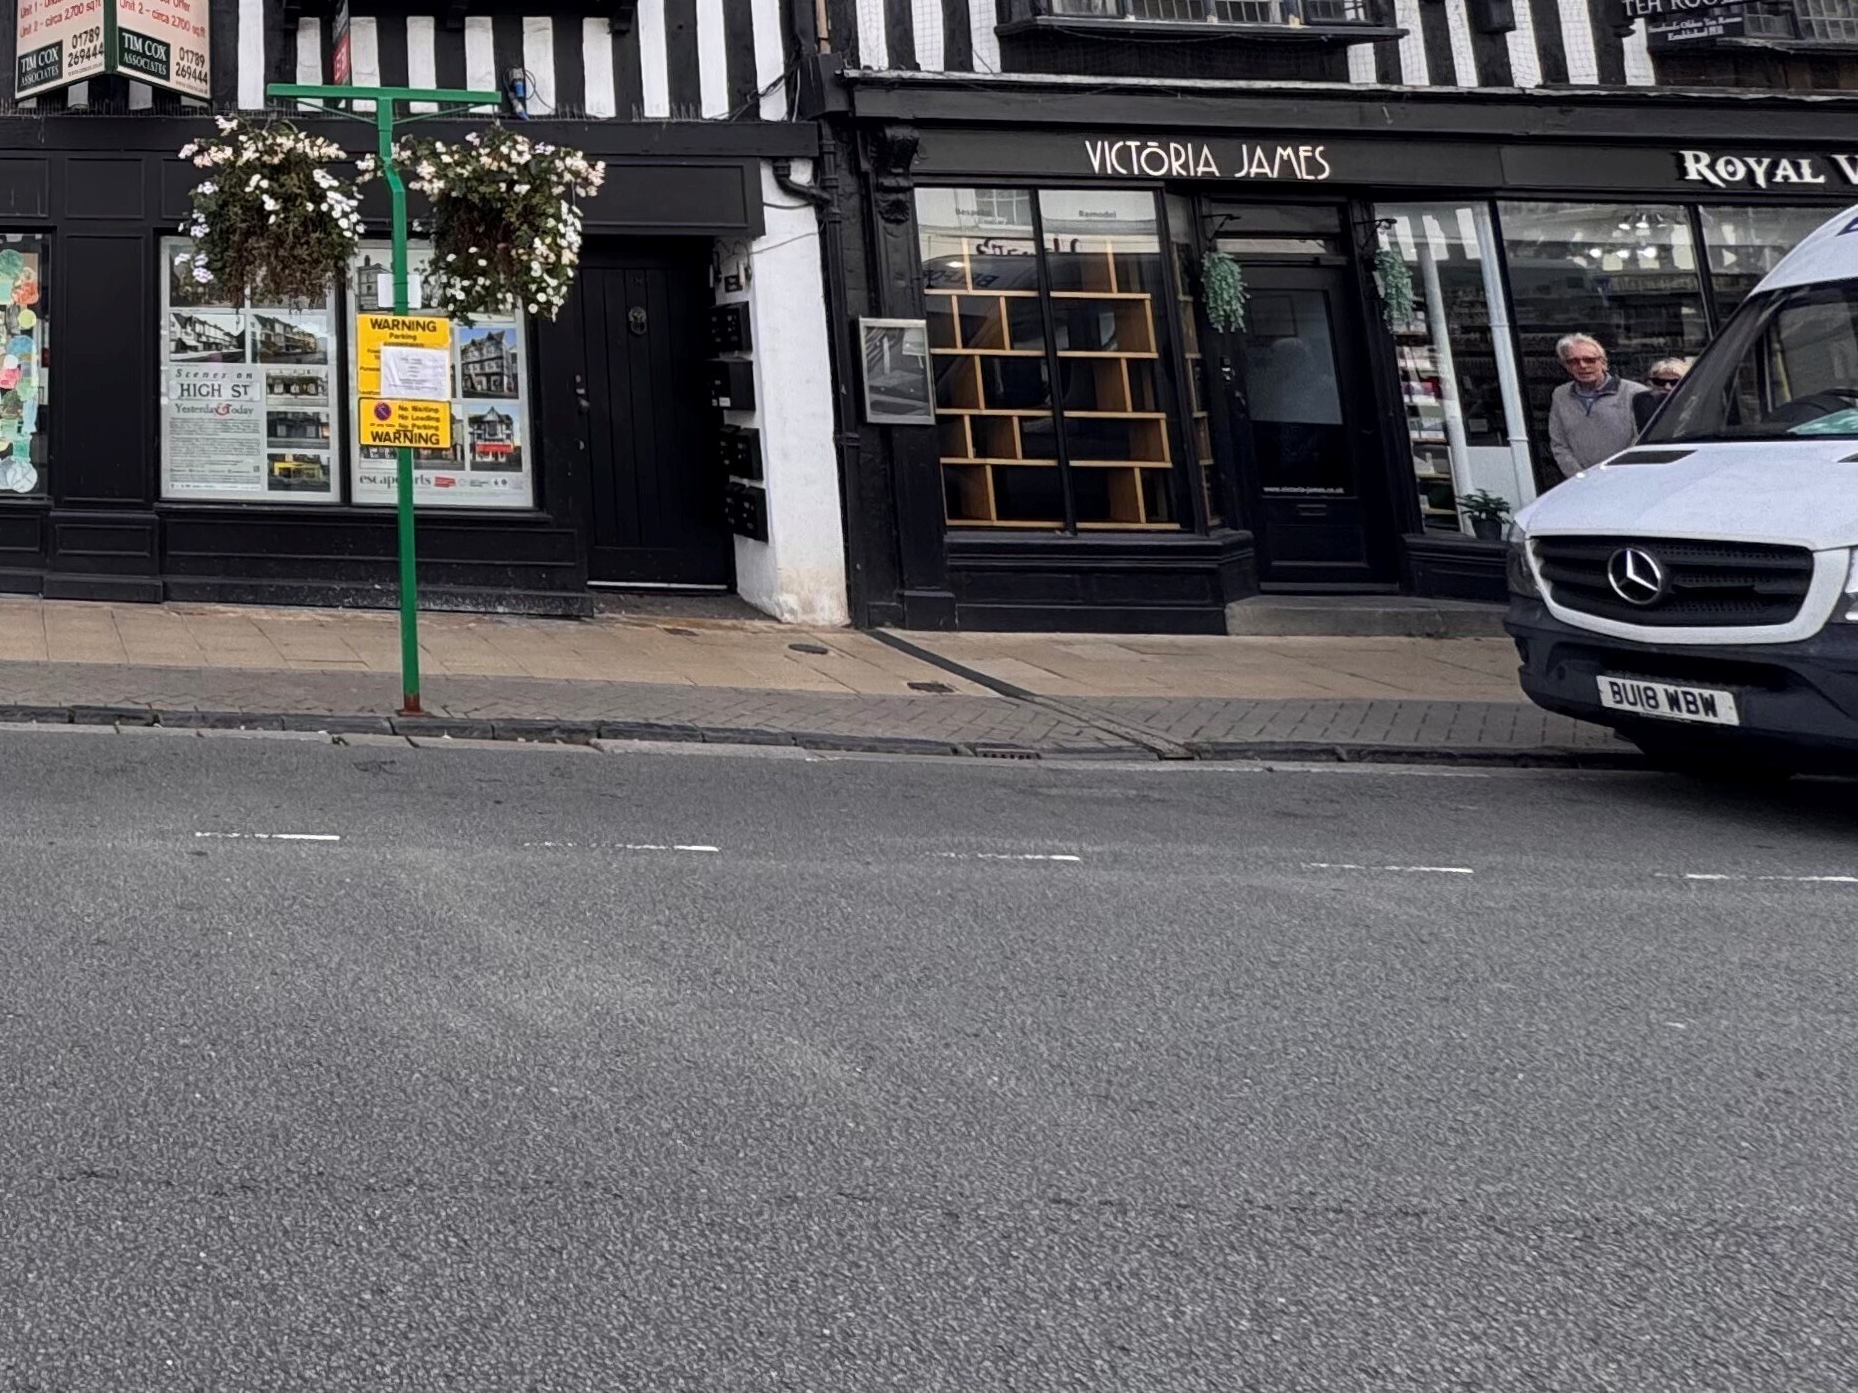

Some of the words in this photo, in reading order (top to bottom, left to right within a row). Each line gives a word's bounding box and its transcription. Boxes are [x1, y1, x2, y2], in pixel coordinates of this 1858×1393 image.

[72, 26, 100, 49] 01789
[122, 32, 143, 53] TIM
[144, 40, 167, 62] COX
[21, 57, 37, 73] TIM
[38, 46, 59, 67] COX
[67, 42, 104, 68] 269444
[123, 52, 167, 76] ASSOCIATES
[179, 46, 205, 68] 01789
[20, 64, 59, 86] ASSOCIATES
[175, 62, 208, 85] 269444
[1234, 144, 1331, 180] JAMES
[1678, 149, 1826, 189] ROYAL
[1078, 209, 1117, 219] Remodel
[370, 318, 437, 332] WARNING
[389, 332, 417, 341] Parking
[180, 383, 222, 398] HIGH
[231, 384, 250, 398] ST
[371, 431, 440, 445] WARNING
[1608, 681, 1660, 710] BU18
[1663, 688, 1719, 718] WBW
